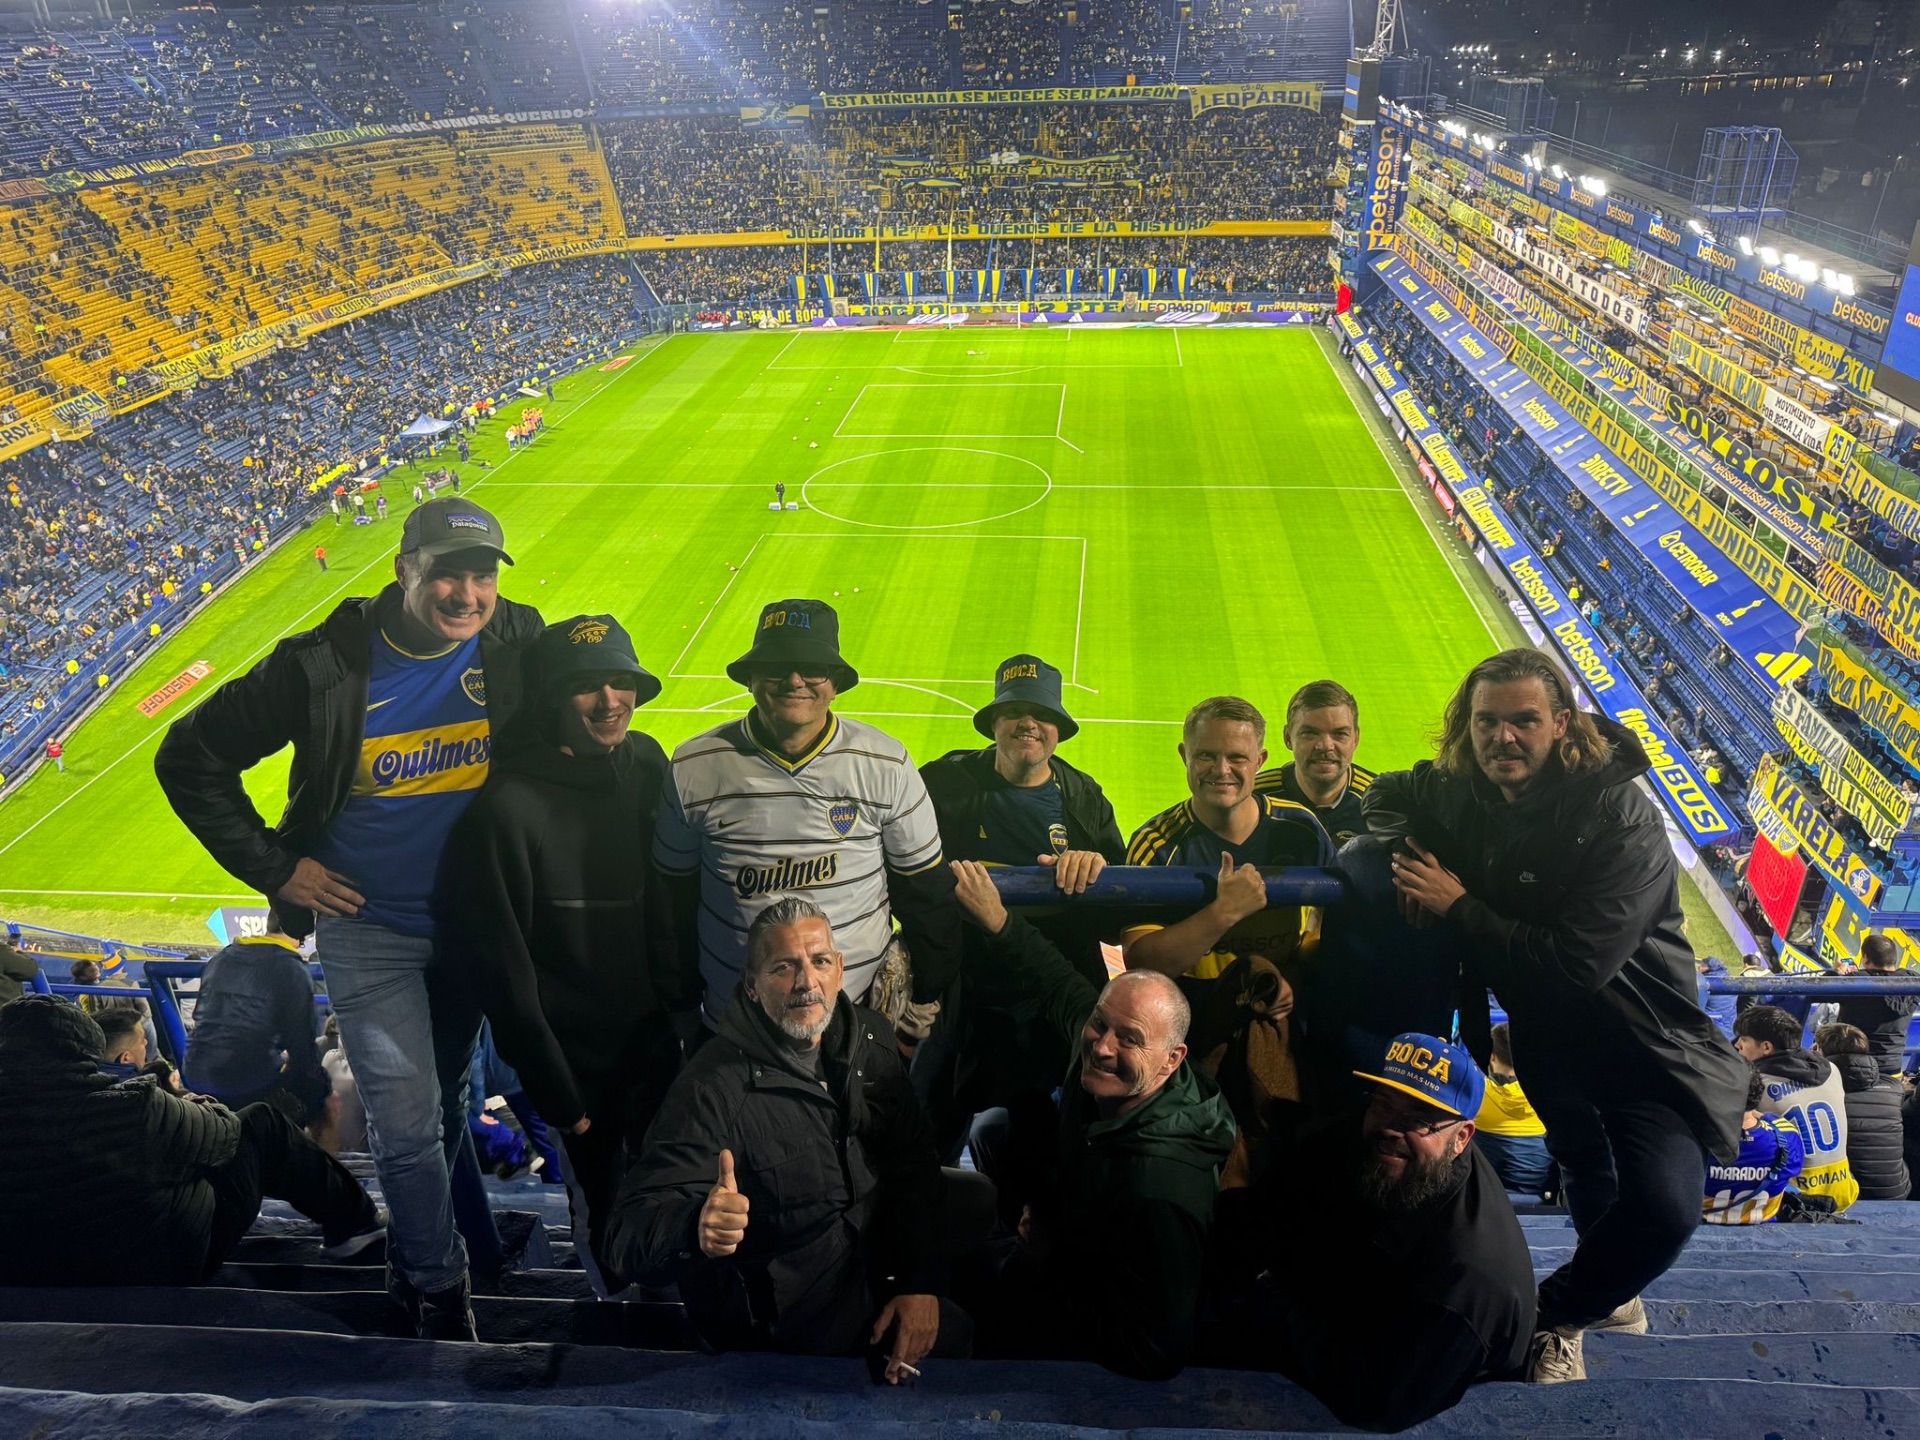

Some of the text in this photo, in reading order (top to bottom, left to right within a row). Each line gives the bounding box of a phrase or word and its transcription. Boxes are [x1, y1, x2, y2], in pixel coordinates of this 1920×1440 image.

[826, 94, 870, 107] ESTA
[872, 92, 956, 105] HINCHADA
[962, 91, 984, 102] SE
[987, 89, 1043, 102] MERECE
[1060, 88, 1092, 101] SER
[1201, 89, 1310, 107] LEOPARDI
[430, 112, 501, 132] JUNIORS
[503, 108, 586, 124] QUERIDO
[990, 151, 1019, 165] 12
[1366, 126, 1397, 236] betsson
[1570, 186, 1595, 209] betsson
[1060, 222, 1084, 234] DE
[1094, 221, 1118, 233] LA
[1606, 202, 1636, 226] betsson
[1648, 218, 1682, 247] betsson
[533, 238, 599, 261] GARRAHAN
[1696, 239, 1738, 272] betsson
[1520, 242, 1574, 289] CONTRA
[1579, 278, 1634, 324] TODOS
[1758, 265, 1806, 300] betsson
[1517, 286, 1563, 333] LEOPARDI
[1758, 312, 1797, 342] BARRIO
[1356, 338, 1379, 365] betsson
[159, 358, 200, 379] MARCOS
[1371, 361, 1398, 391] betsson
[52, 391, 108, 422] HUDSON
[1521, 396, 1561, 432] betsson
[1775, 396, 1816, 429] MOVIMIENTO
[1667, 395, 1728, 452] SOY
[1793, 423, 1802, 442] LA
[1804, 431, 1824, 453] VIDA
[1829, 432, 1843, 460] 25
[1513, 346, 1553, 390] SIEMPRE
[1551, 377, 1593, 426] ESTARE
[1592, 415, 1604, 436] A
[1603, 423, 1621, 450] TU
[1659, 470, 1702, 526] BOCA
[1702, 513, 1784, 596] JUNIORS
[1577, 452, 1634, 497] DIRECTV
[1711, 460, 1741, 490] betsson
[1841, 462, 1860, 497] EL
[1739, 479, 1771, 510] betsson
[451, 520, 489, 533] patagonia
[1767, 501, 1804, 535] betsson
[1668, 541, 1719, 588] CETROGAR
[1509, 554, 1562, 617] betsson
[762, 610, 811, 631] BOCA
[1553, 618, 1617, 694] betsson
[1001, 663, 1038, 684] BOCA
[1774, 686, 1845, 771] ES FAMILIA
[373, 735, 490, 787] Quilmes
[1846, 750, 1907, 817] DON TORCUATO
[832, 812, 856, 823] CABJ
[1770, 770, 1851, 881] VARELA
[736, 852, 839, 900] Quilmes
[1385, 1041, 1451, 1085] BOCA
[1782, 1101, 1842, 1157] 10
[1796, 1167, 1848, 1191] ROMAN
